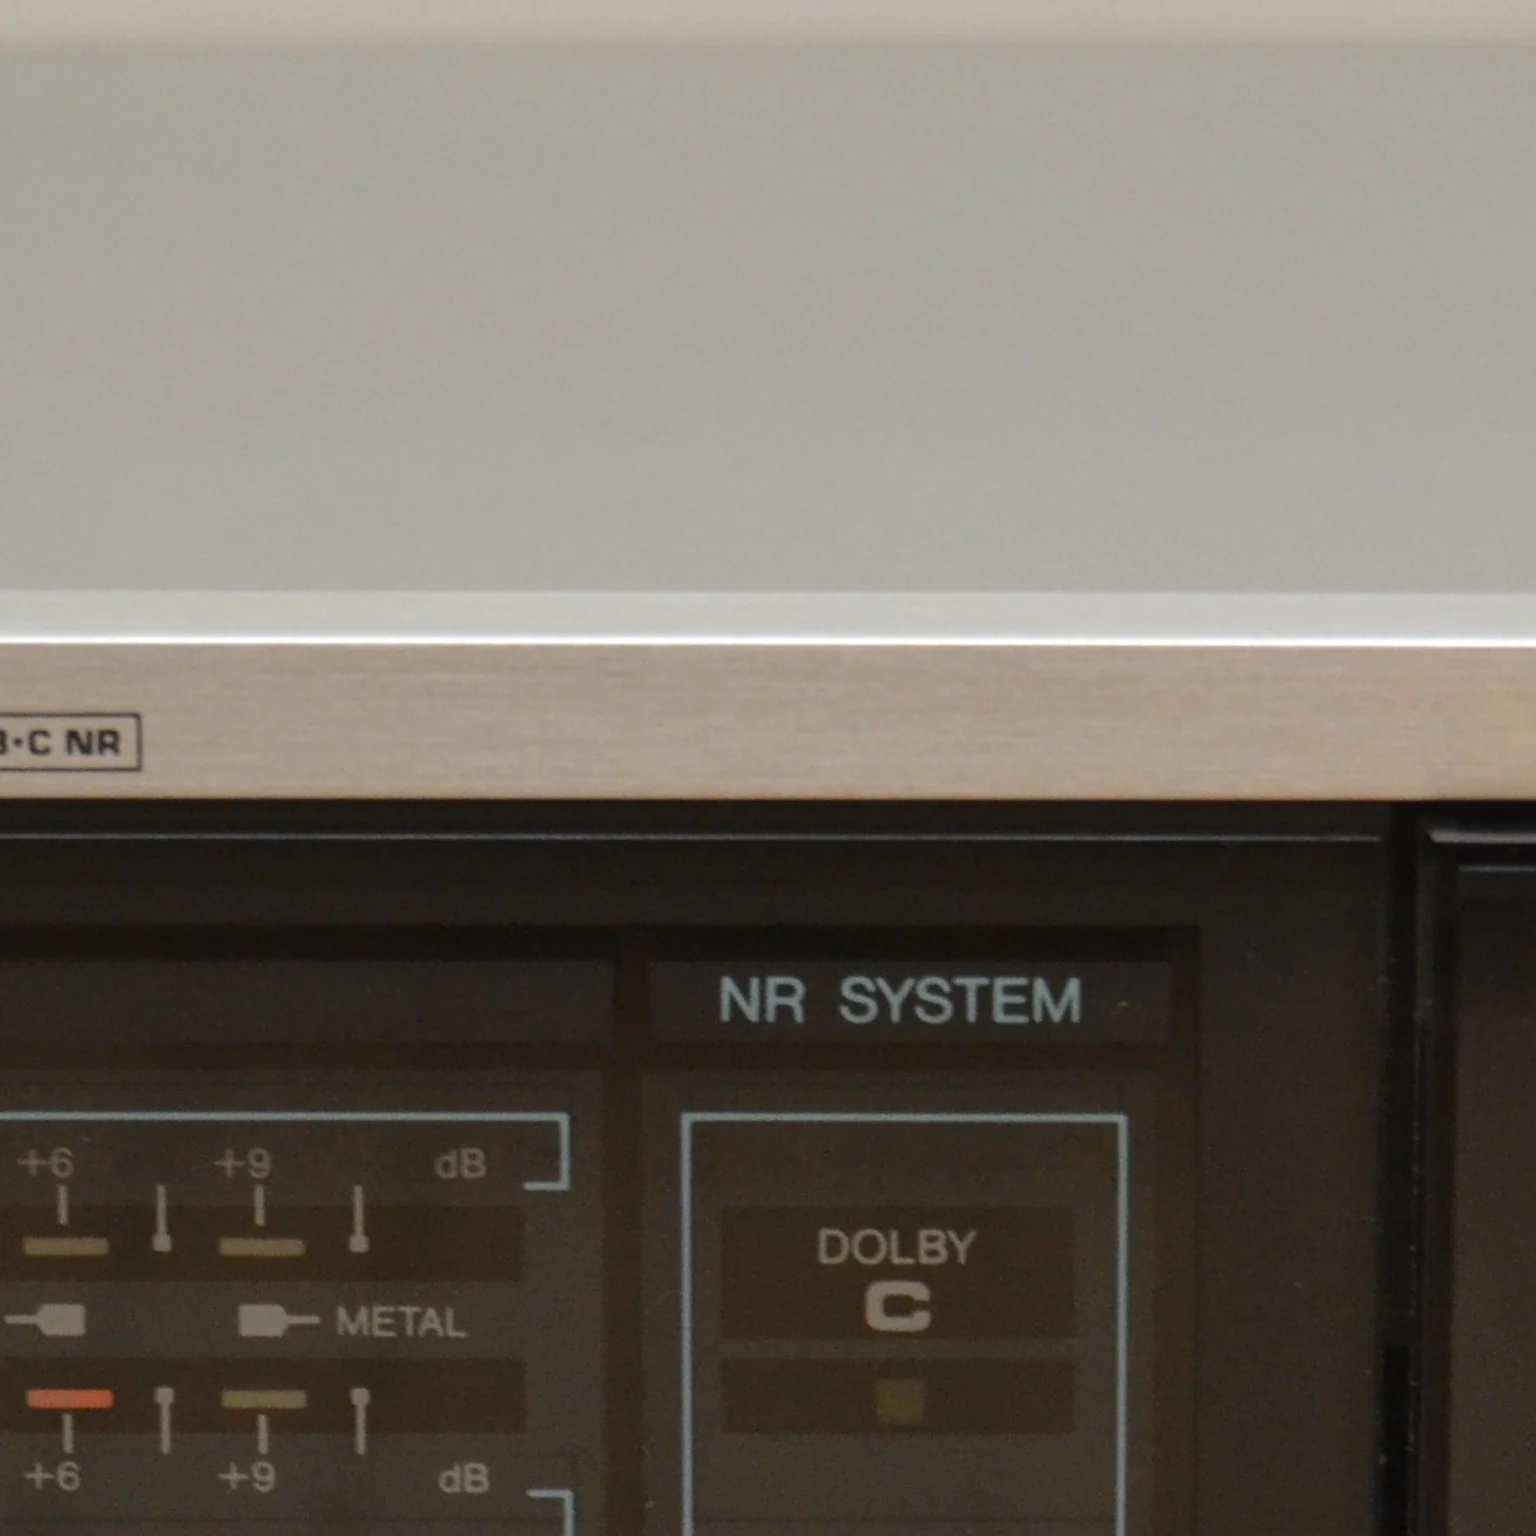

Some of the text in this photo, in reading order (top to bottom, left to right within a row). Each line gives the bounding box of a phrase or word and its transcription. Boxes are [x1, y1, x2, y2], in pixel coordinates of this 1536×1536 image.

[66, 729, 120, 755] NR
[721, 976, 1080, 1024] NR SYSTEM
[18, 1147, 73, 1178] +6
[215, 1148, 271, 1179] +9
[436, 1147, 486, 1179] dB
[819, 1228, 976, 1265] DOLBY
[337, 1305, 467, 1338] METAL
[866, 1280, 931, 1332] C
[25, 1461, 80, 1491] +6
[219, 1461, 276, 1492] +9
[439, 1462, 489, 1494] dB
